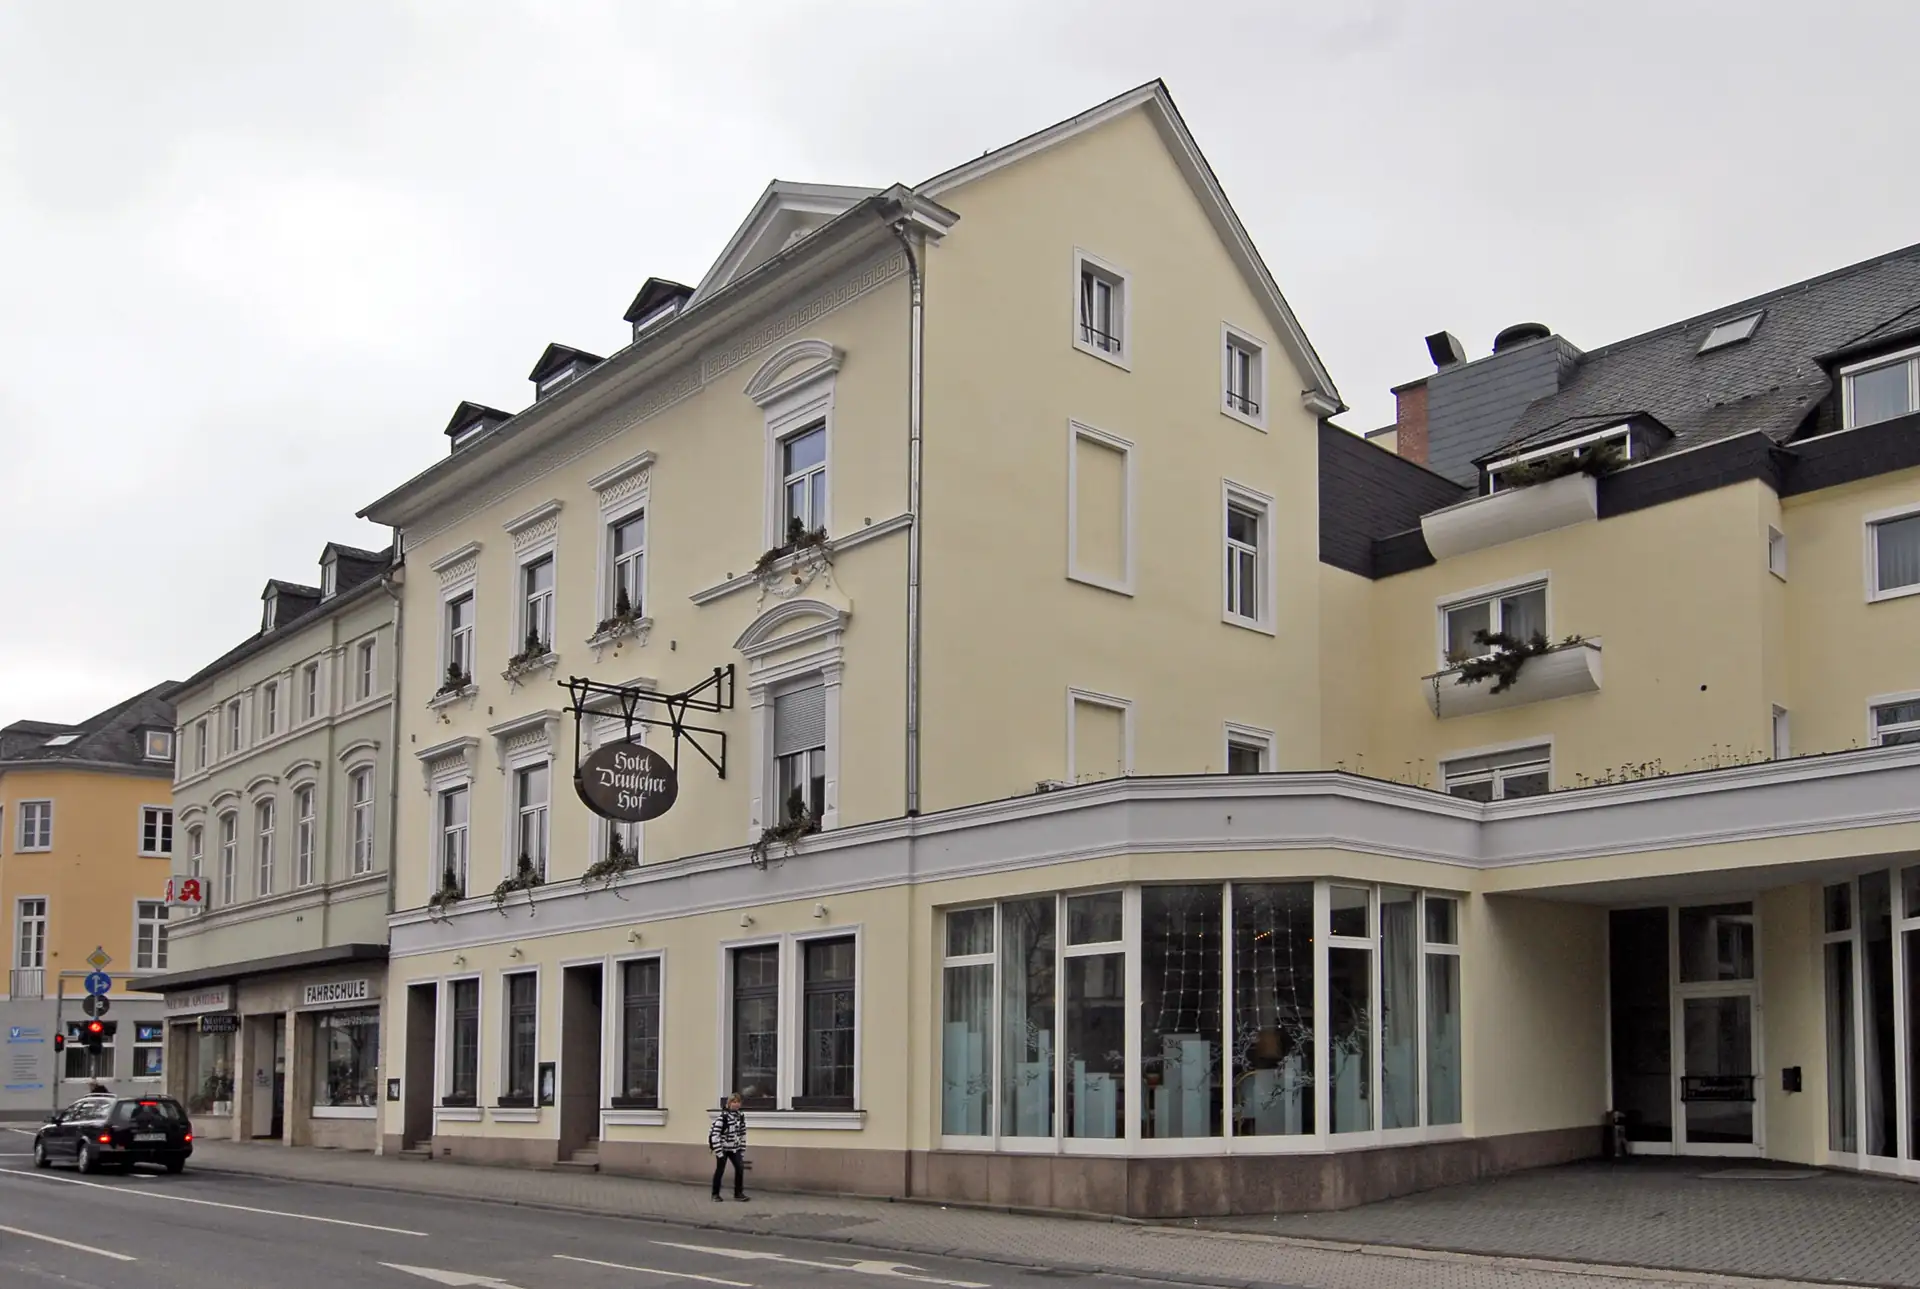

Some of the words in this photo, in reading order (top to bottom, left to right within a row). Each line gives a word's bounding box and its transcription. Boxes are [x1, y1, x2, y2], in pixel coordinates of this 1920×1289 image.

[614, 751, 652, 772] Hotel
[617, 790, 647, 811] Hof
[307, 981, 365, 1002] FAHRSCHULE
